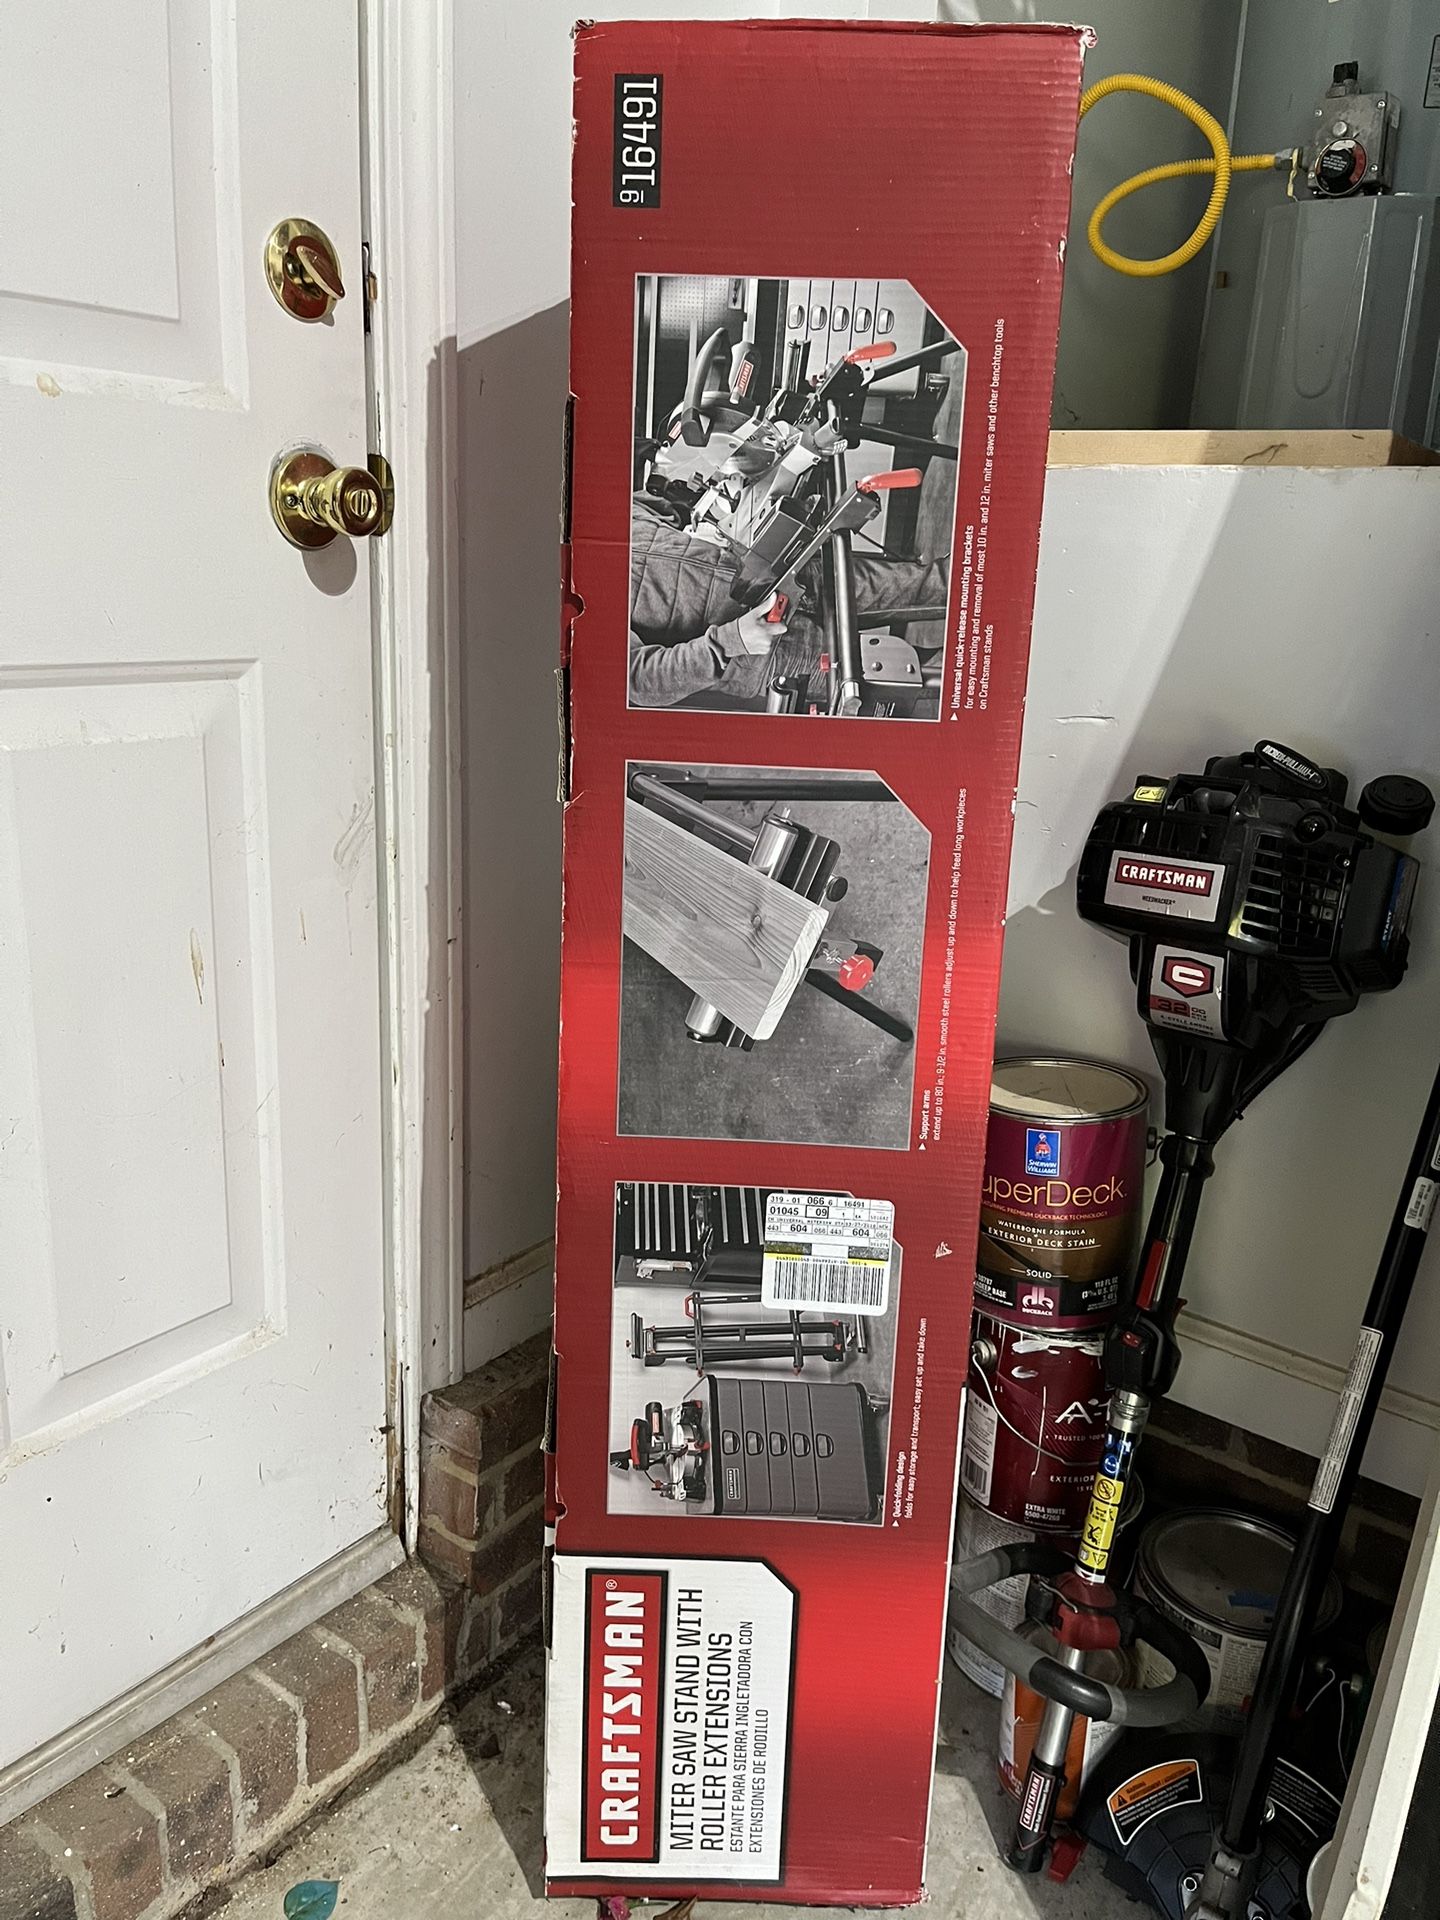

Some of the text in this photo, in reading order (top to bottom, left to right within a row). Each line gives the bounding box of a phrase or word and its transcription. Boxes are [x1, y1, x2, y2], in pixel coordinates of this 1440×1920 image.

[965, 319, 1004, 709] for easy mounting and removal of most 10 in. and 12 in. miter saws and other benchtop tools
[951, 525, 974, 708] Universal quick-release mounting brackets
[979, 625, 993, 709] on Craftsman stands
[956, 788, 967, 833] workpieces
[954, 835, 964, 851] long
[952, 853, 961, 870] feed
[951, 872, 961, 888] help
[1122, 865, 1206, 889] CRAFTSMAN
[951, 890, 958, 898] to
[949, 900, 958, 919] down
[948, 921, 956, 935] and
[948, 937, 956, 946] up
[945, 948, 954, 971] adjust
[943, 973, 952, 996] rollers
[942, 998, 950, 1016] steel
[1157, 999, 1187, 1015] 32
[940, 1019, 948, 1045] smooth
[935, 1087, 943, 1096] 80
[919, 1090, 931, 1139] Support arms
[935, 1107, 944, 1116] up
[933, 1117, 942, 1140] extend
[1027, 1166, 1057, 1174] WILLIAMS
[1029, 1159, 1057, 1168] SHERWIN
[770, 1207, 798, 1215] 01045
[816, 1208, 827, 1216] 09
[790, 1224, 807, 1232] 604
[998, 1220, 1046, 1235] WATERBORNE
[988, 1226, 1095, 1247] EXTERIOR DECK STAIN
[1026, 1269, 1051, 1279] SOLID
[1022, 1308, 1053, 1316] DUCKBACK
[918, 1318, 927, 1336] down
[917, 1337, 926, 1352] take
[916, 1353, 925, 1366] and
[915, 1376, 923, 1387] set
[915, 1388, 923, 1403] easy
[910, 1438, 919, 1449] and
[1054, 1434, 1086, 1442] TRUSTED
[909, 1451, 919, 1475] storage
[892, 1451, 907, 1517] Quick-folding design
[908, 1476, 917, 1491] easy
[1050, 1475, 1094, 1483] EXTERIOR
[906, 1493, 914, 1501] for
[904, 1503, 914, 1518] folds
[1025, 1503, 1046, 1513] EXTRA
[670, 1589, 703, 1850] MITER SAW STAND WITH
[700, 1632, 732, 1851] ROLLER EXTENSIONS
[730, 1621, 753, 1852] ESTANTE PARA SIERRA INGLETADORA CON
[749, 1709, 769, 1853] EXTENSIONES DE RODILLO
[1022, 1777, 1040, 1824] CRAFTSMAN
